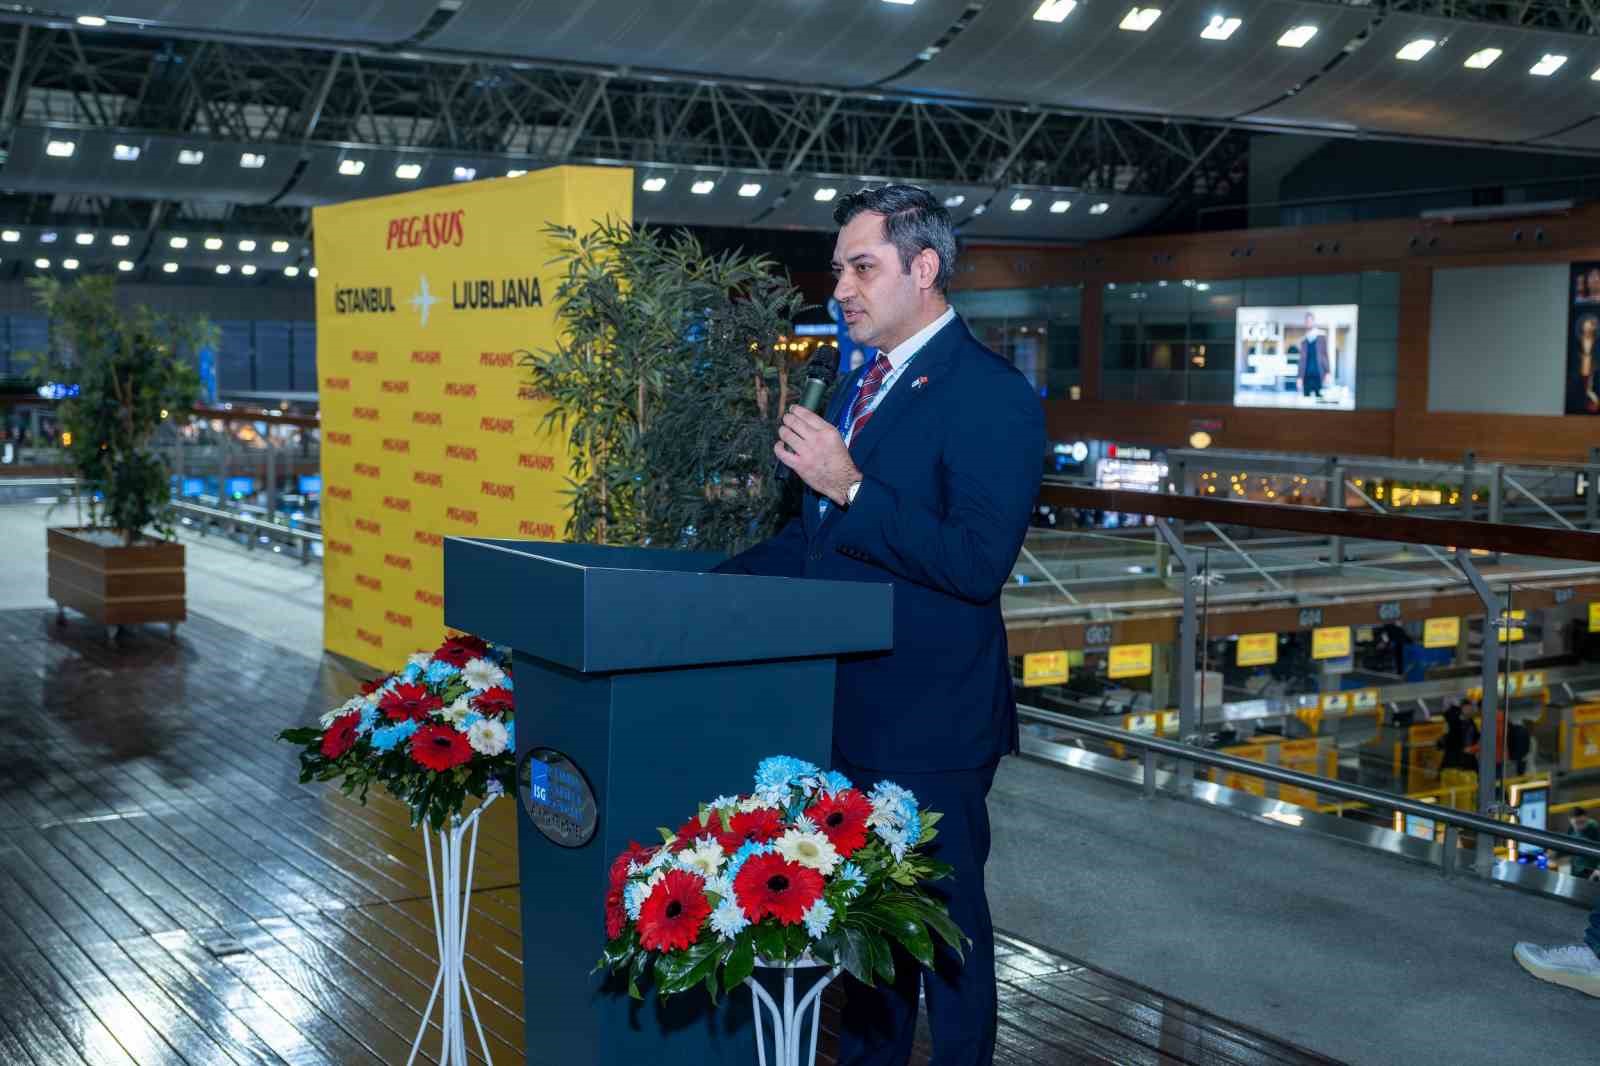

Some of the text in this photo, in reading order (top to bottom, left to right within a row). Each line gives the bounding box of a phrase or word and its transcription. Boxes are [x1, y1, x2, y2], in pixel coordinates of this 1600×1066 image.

[386, 209, 465, 250] PEGASUS
[334, 277, 544, 314] İSTANBUL LJUBLJANA
[518, 453, 555, 472] PEGASUS
